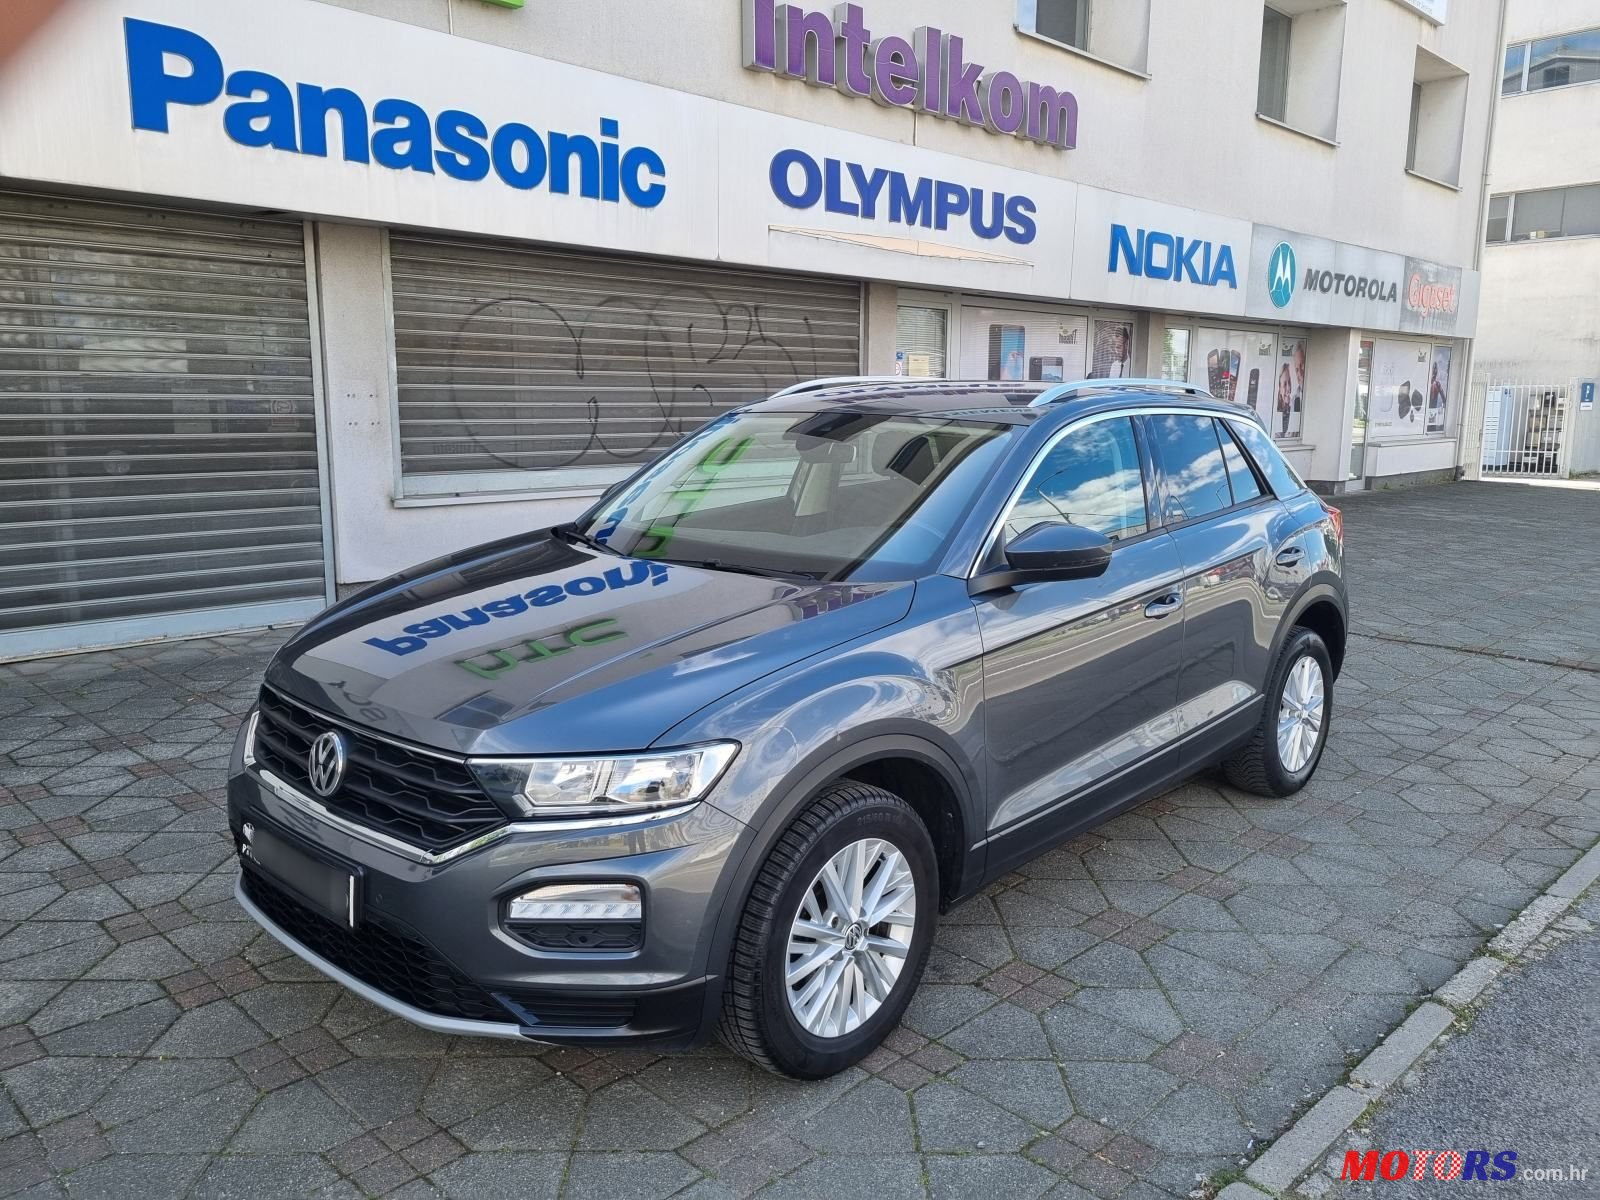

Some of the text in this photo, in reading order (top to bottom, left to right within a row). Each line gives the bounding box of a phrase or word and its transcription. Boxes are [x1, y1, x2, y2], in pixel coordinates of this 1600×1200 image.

[123, 17, 667, 208] Panasonic
[742, 0, 1079, 150] Intelkom
[769, 148, 1037, 245] OLYMPUS
[1108, 223, 1238, 289] NOKIA
[1303, 268, 1398, 303] MOTOROLA
